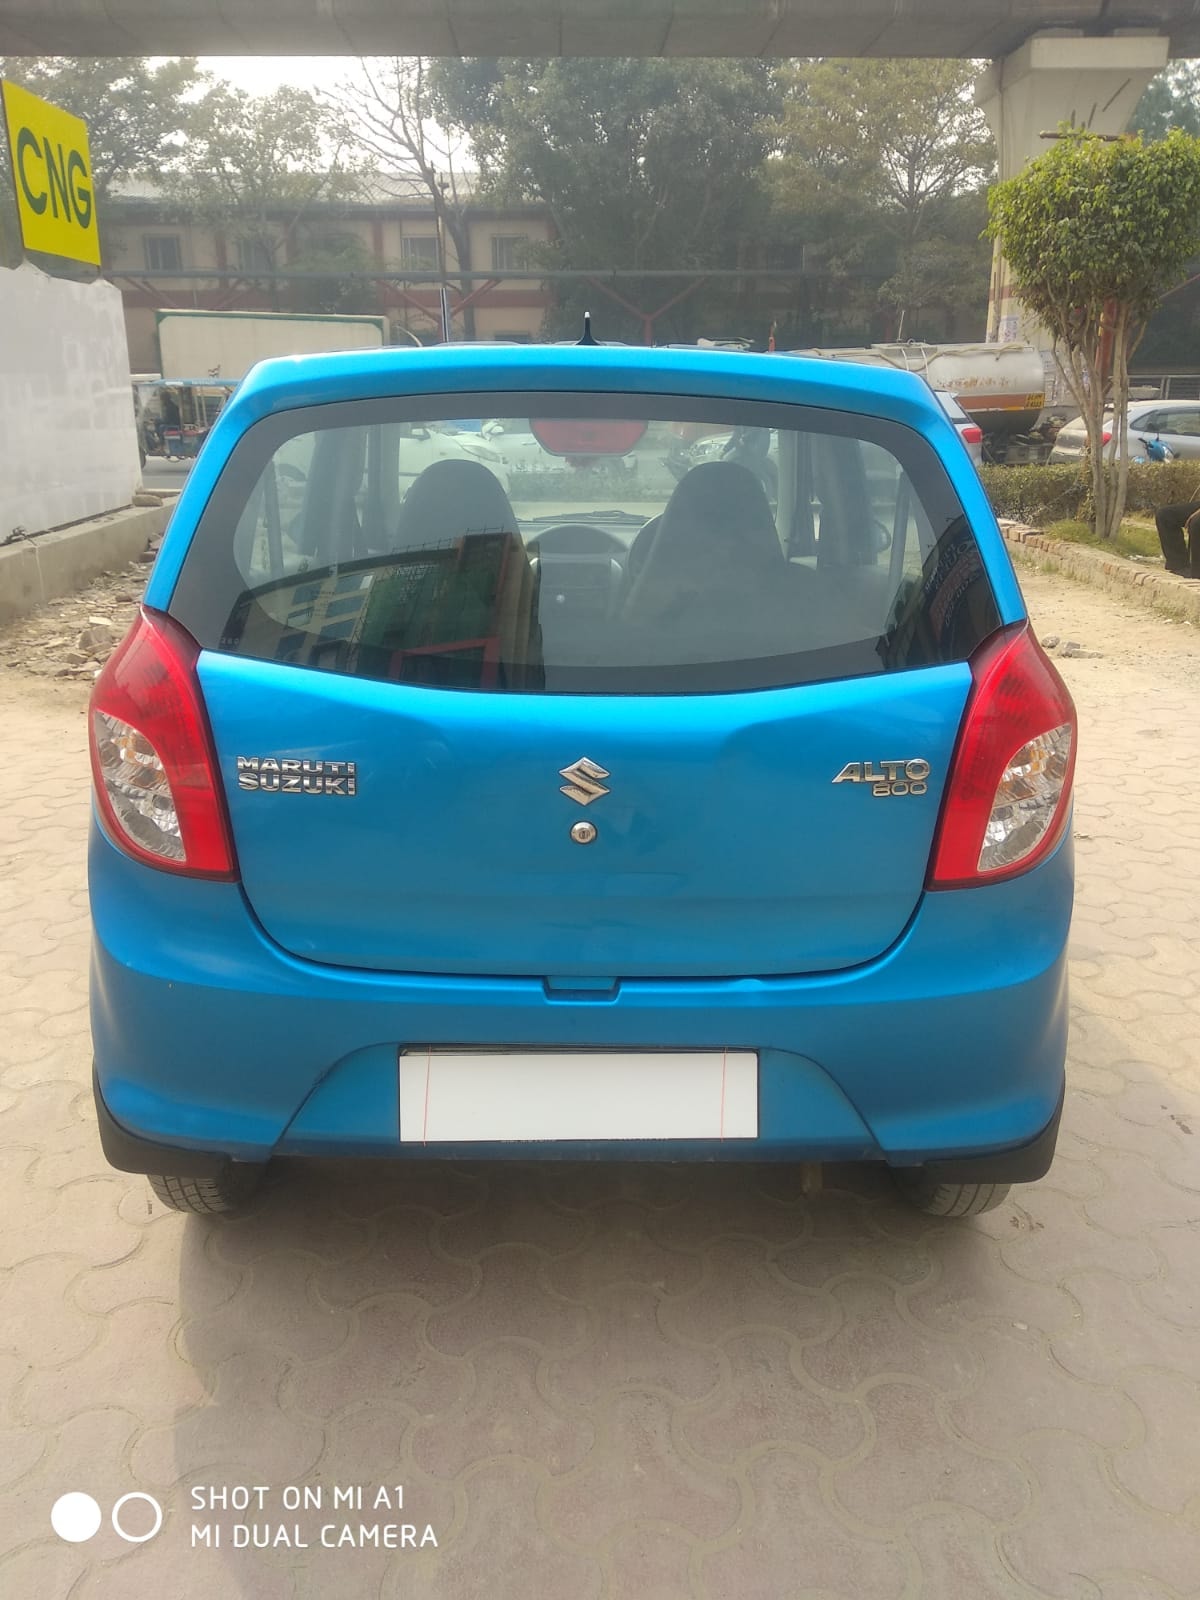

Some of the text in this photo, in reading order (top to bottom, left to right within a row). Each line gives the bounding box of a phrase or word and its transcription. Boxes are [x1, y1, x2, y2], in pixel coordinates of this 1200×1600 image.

[16, 126, 92, 229] CNG
[237, 756, 356, 775] MARUTI
[831, 758, 930, 783] ALTO
[238, 772, 356, 796] SUZUKI
[872, 780, 928, 797] 800
